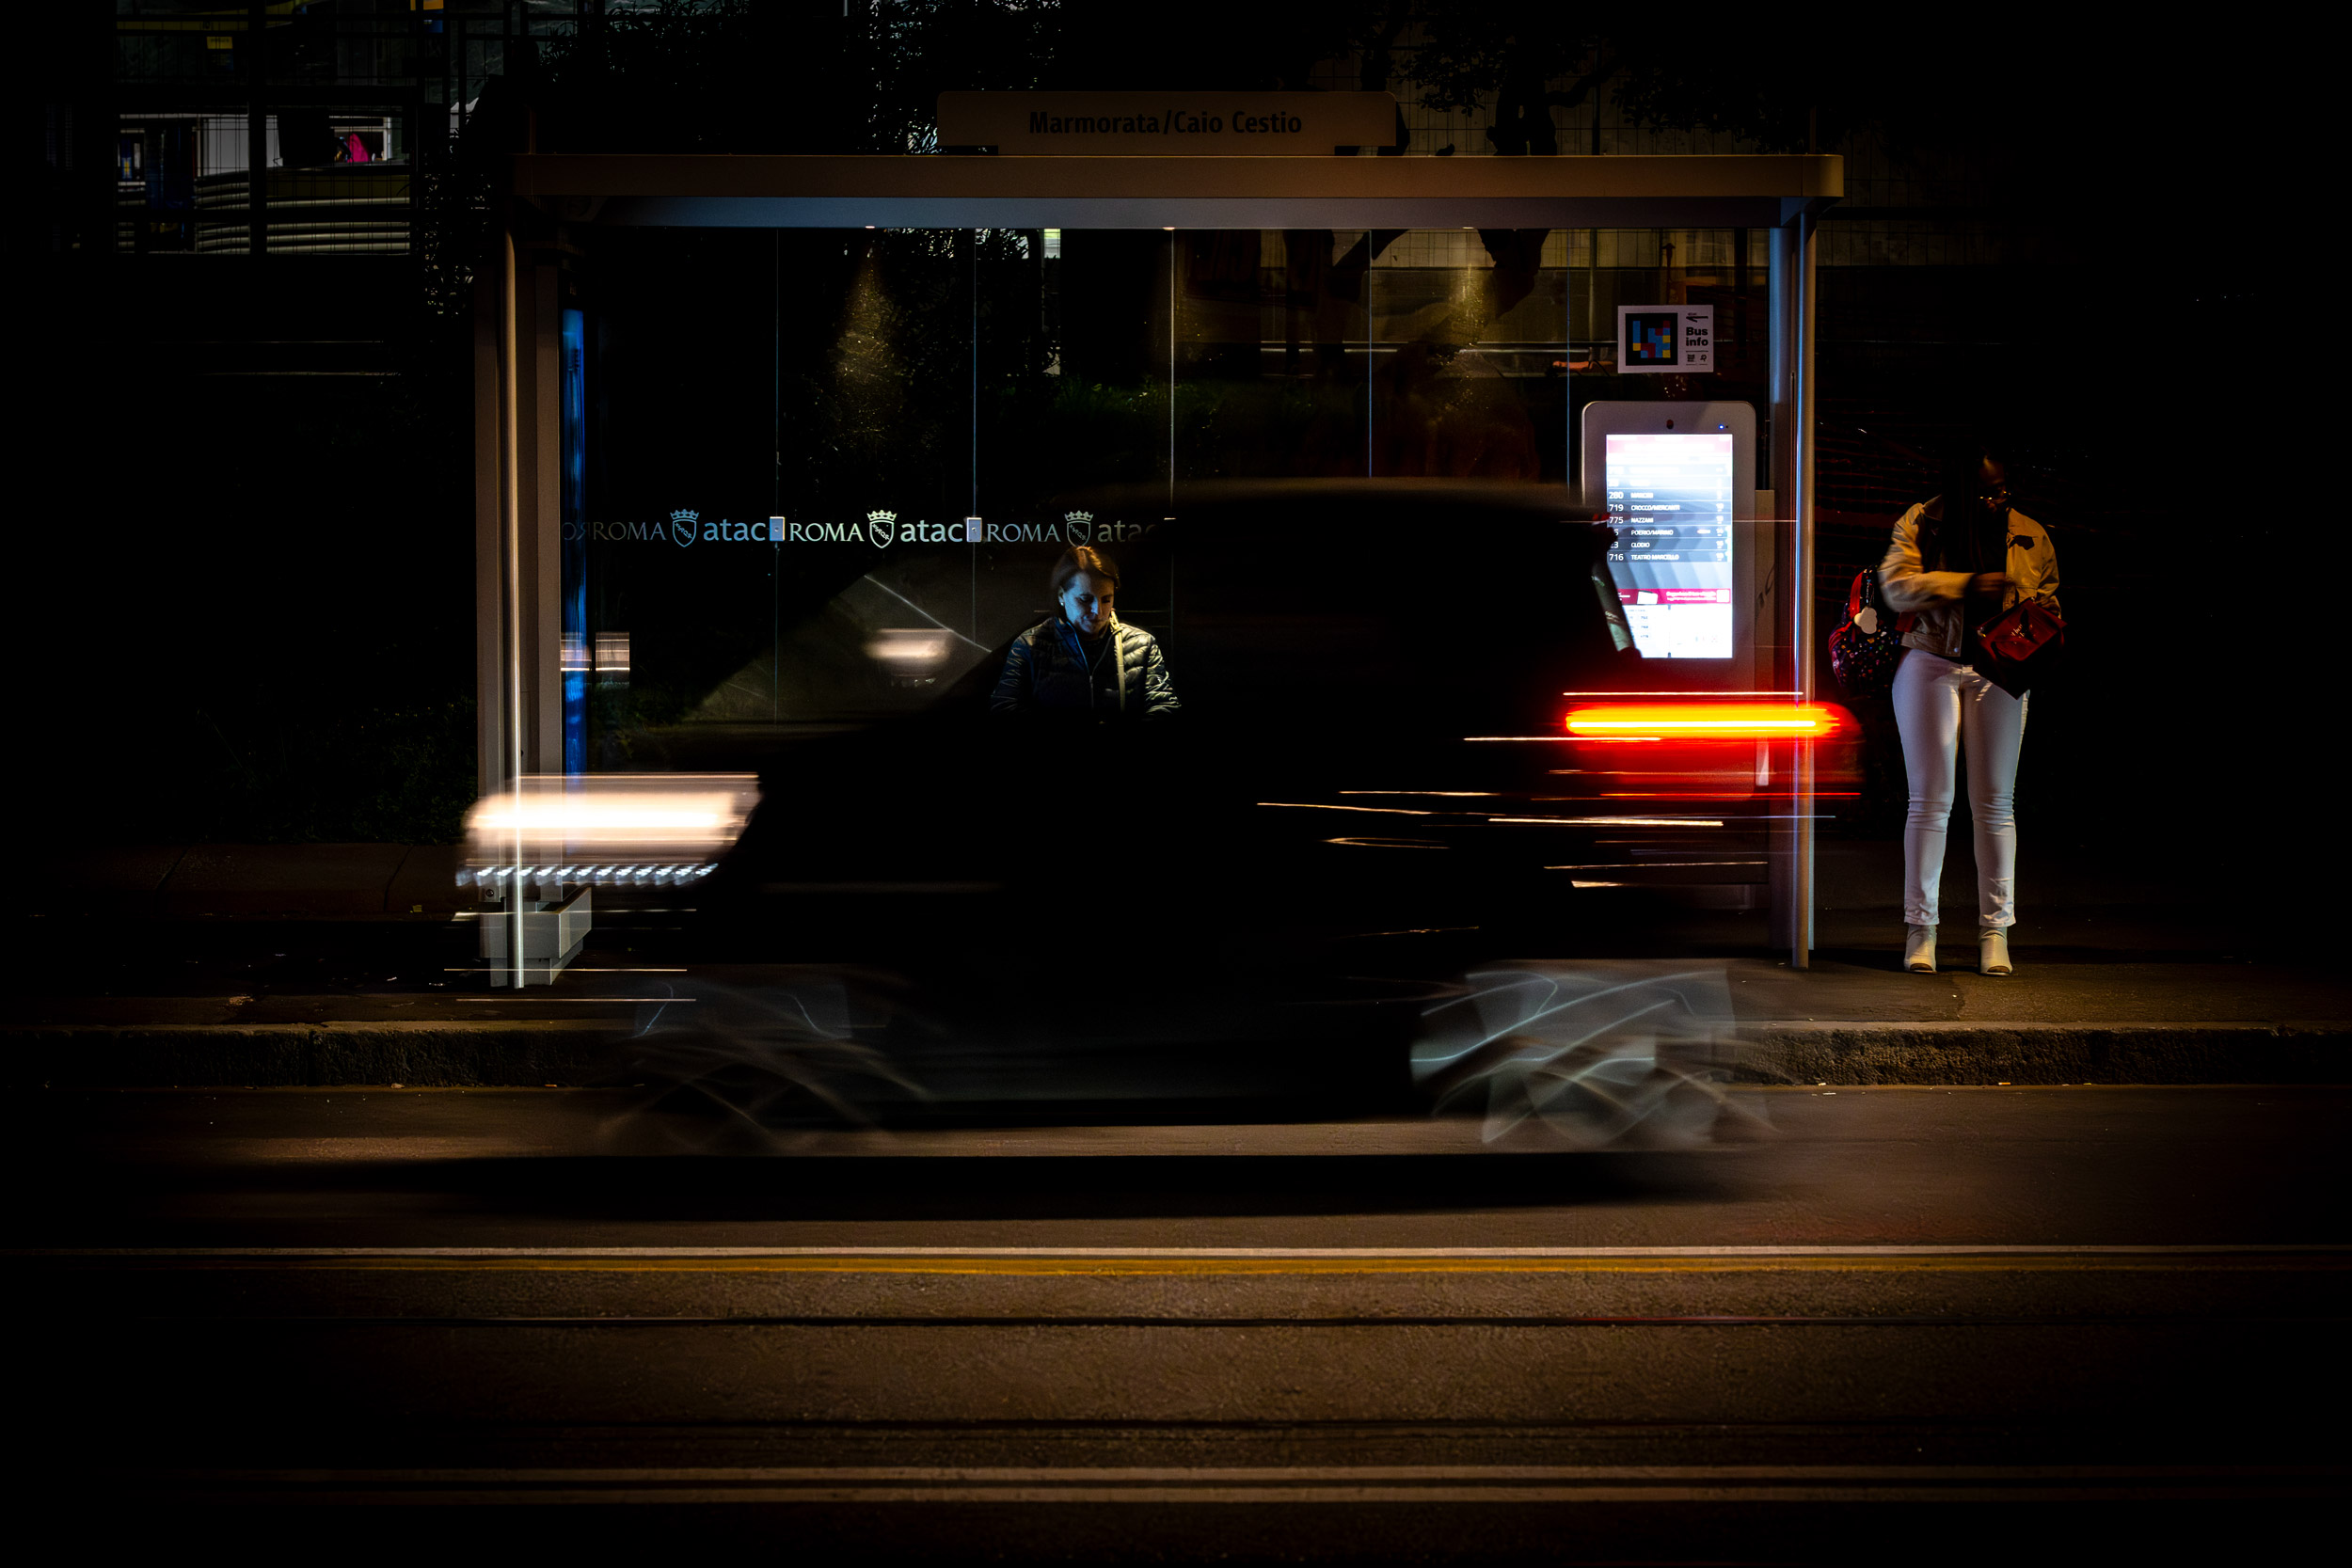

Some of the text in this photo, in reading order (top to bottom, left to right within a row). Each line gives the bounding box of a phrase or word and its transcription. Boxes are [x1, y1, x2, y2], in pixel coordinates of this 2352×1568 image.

[1029, 110, 1303, 134] Marmorata/Caio Cestio
[1685, 326, 1708, 336] Bus
[1685, 337, 1708, 346] info
[593, 521, 668, 542] ROMA
[703, 518, 767, 542] atac
[788, 522, 866, 542] ROMA
[899, 519, 963, 543] atac
[986, 523, 1061, 543] ROMA
